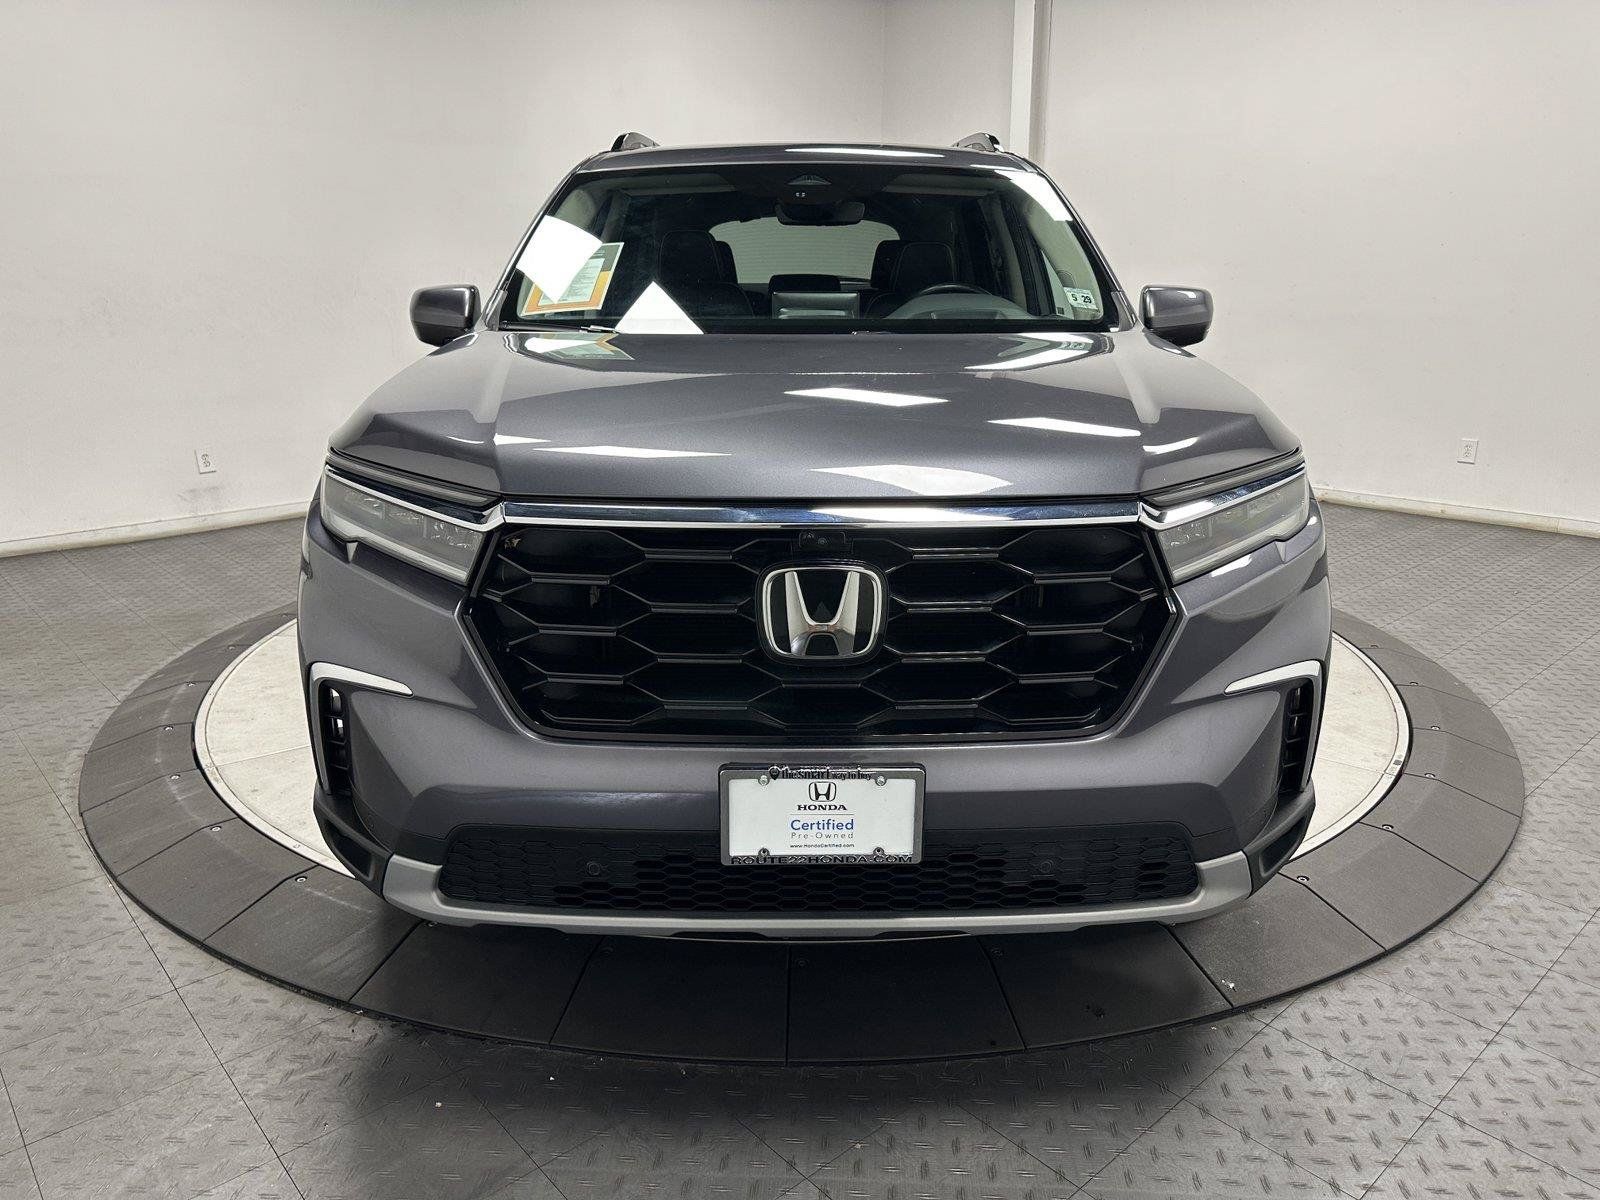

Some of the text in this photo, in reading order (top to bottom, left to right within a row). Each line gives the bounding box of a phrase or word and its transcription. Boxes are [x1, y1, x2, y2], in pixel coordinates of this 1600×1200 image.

[1081, 295, 1092, 304] 29
[790, 818, 854, 831] Certified
[791, 831, 854, 840] Pre-Owned
